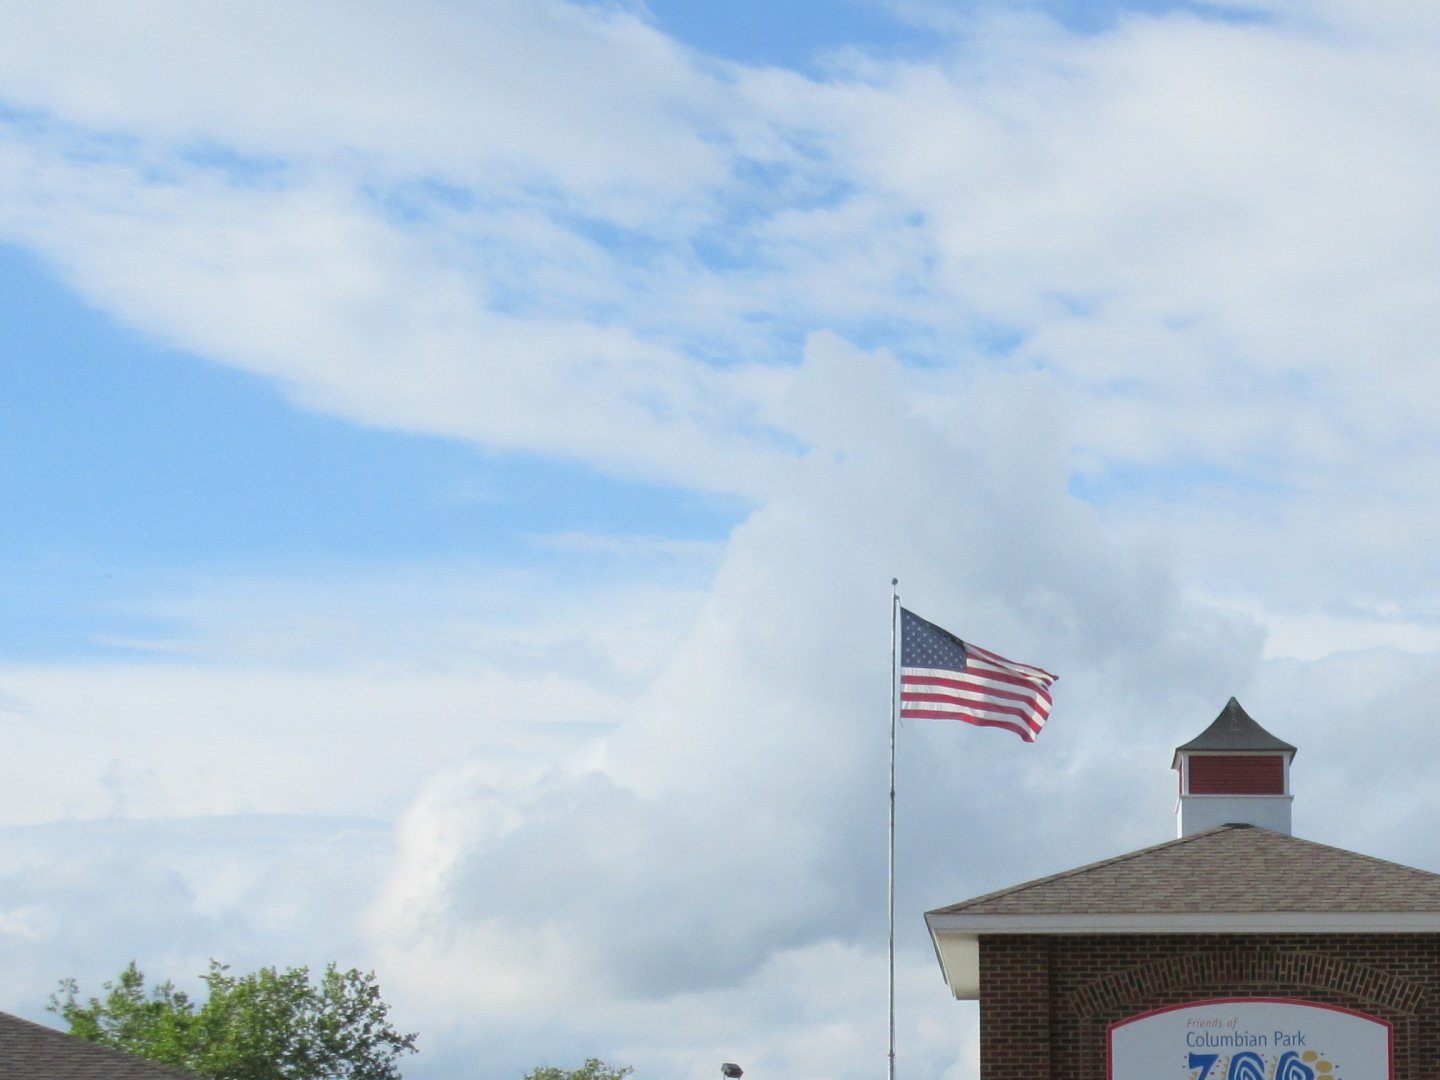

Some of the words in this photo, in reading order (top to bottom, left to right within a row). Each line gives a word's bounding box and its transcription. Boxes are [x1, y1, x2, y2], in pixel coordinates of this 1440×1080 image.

[1186, 1018, 1222, 1028] Friends
[1227, 1017, 1238, 1029] of
[1186, 1031, 1267, 1047] Columbian
[1274, 1031, 1306, 1047] Park
